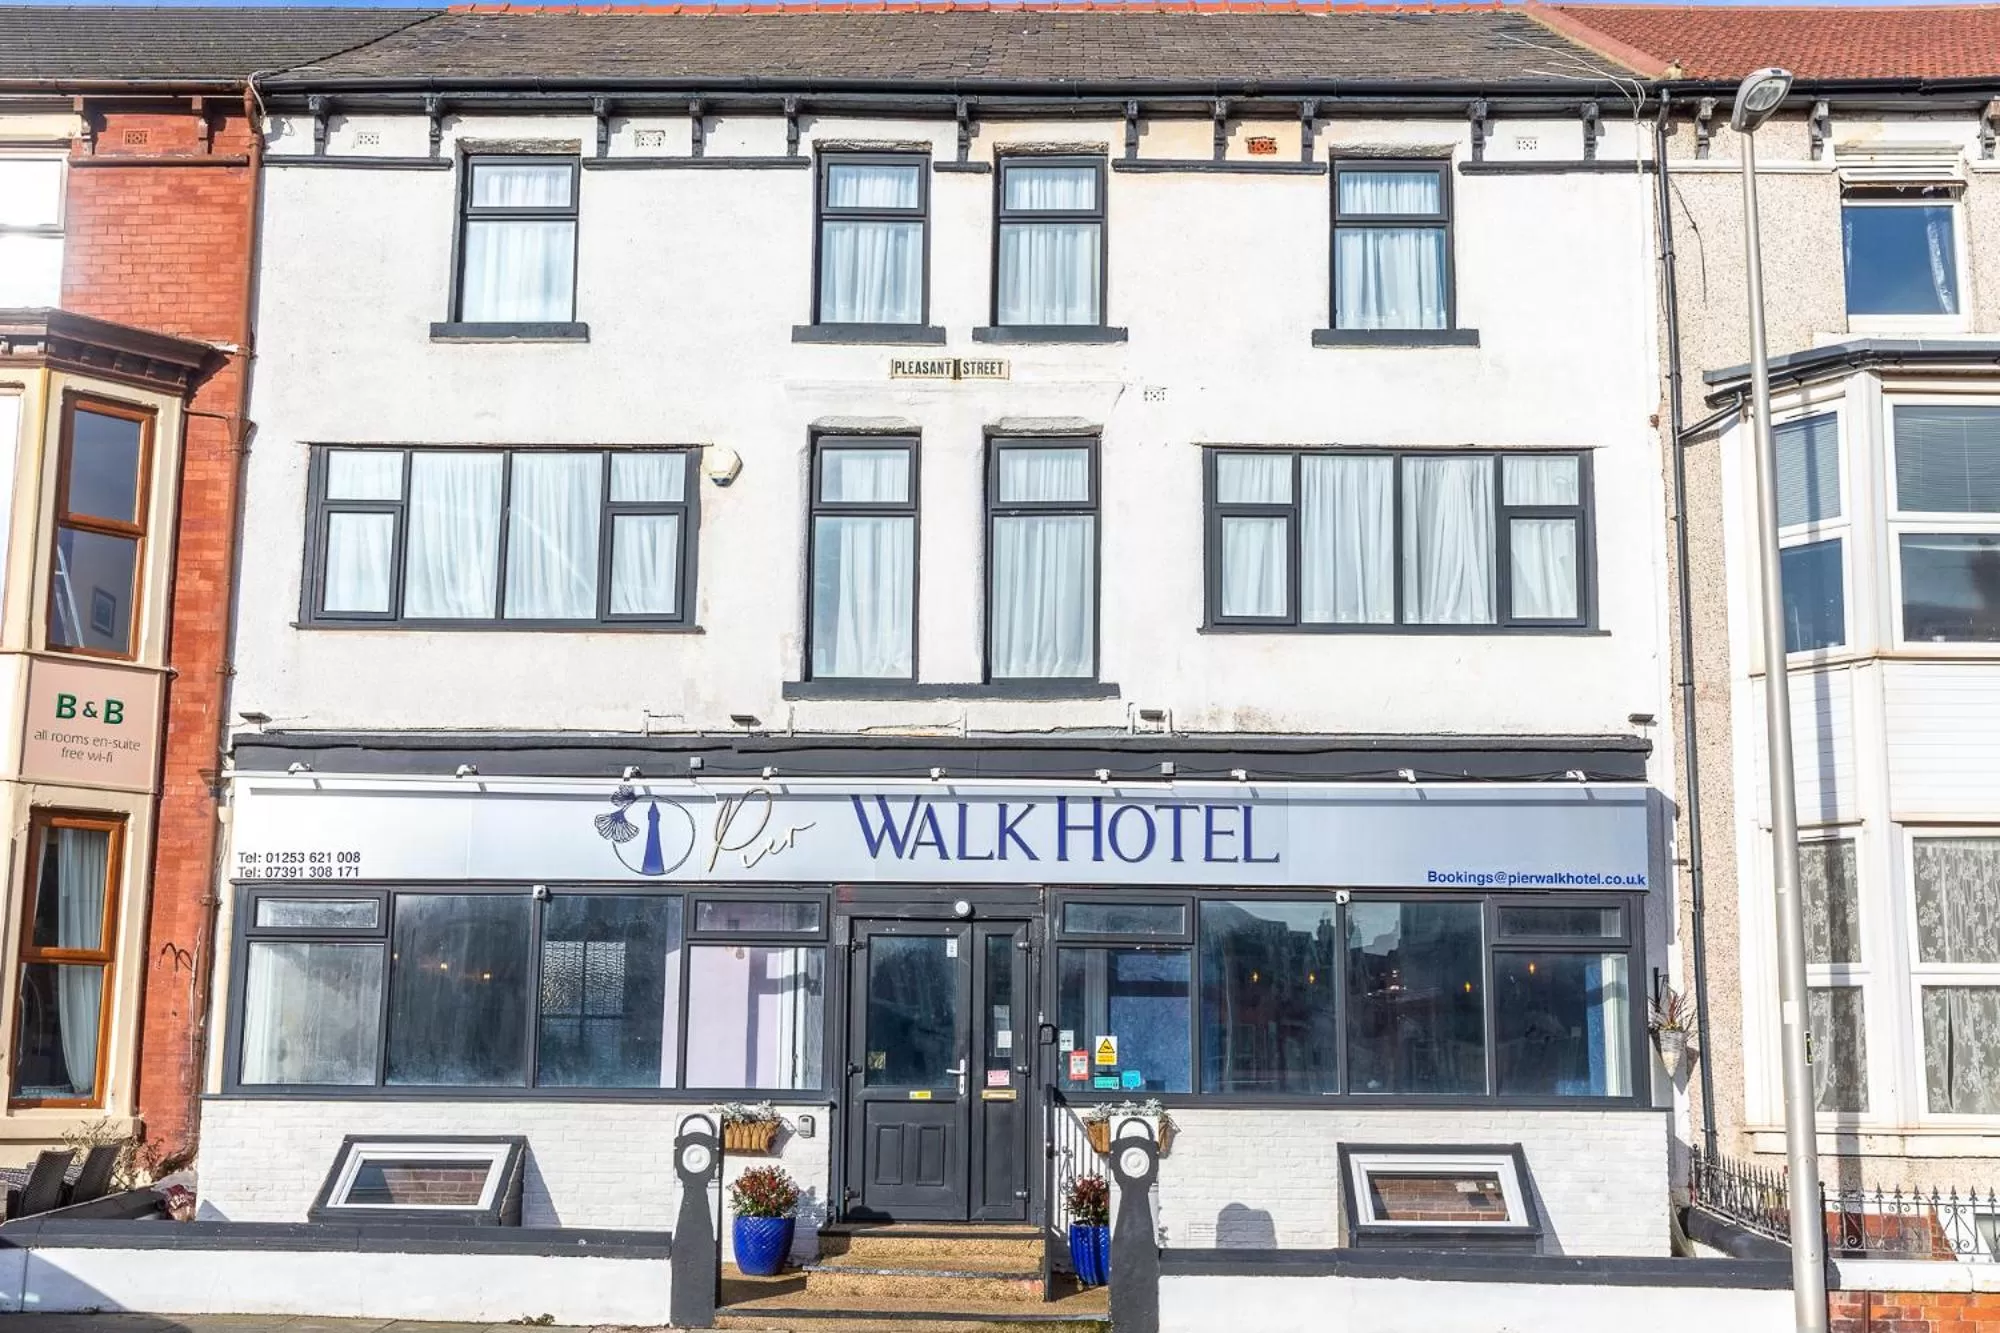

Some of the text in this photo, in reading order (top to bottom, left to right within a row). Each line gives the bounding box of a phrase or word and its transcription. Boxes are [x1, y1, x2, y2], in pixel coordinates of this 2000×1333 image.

[894, 361, 1004, 375] PLEASANT STREET
[56, 693, 124, 725] B & B
[34, 730, 141, 751] all rooms en-suite
[61, 747, 113, 763] free wi-fi
[238, 852, 361, 864] Tel: 01253 621 008
[238, 866, 360, 878] Tel: 07391 308 171
[1427, 870, 1646, 886] Bookings@pierwalkhotel.co.uk
